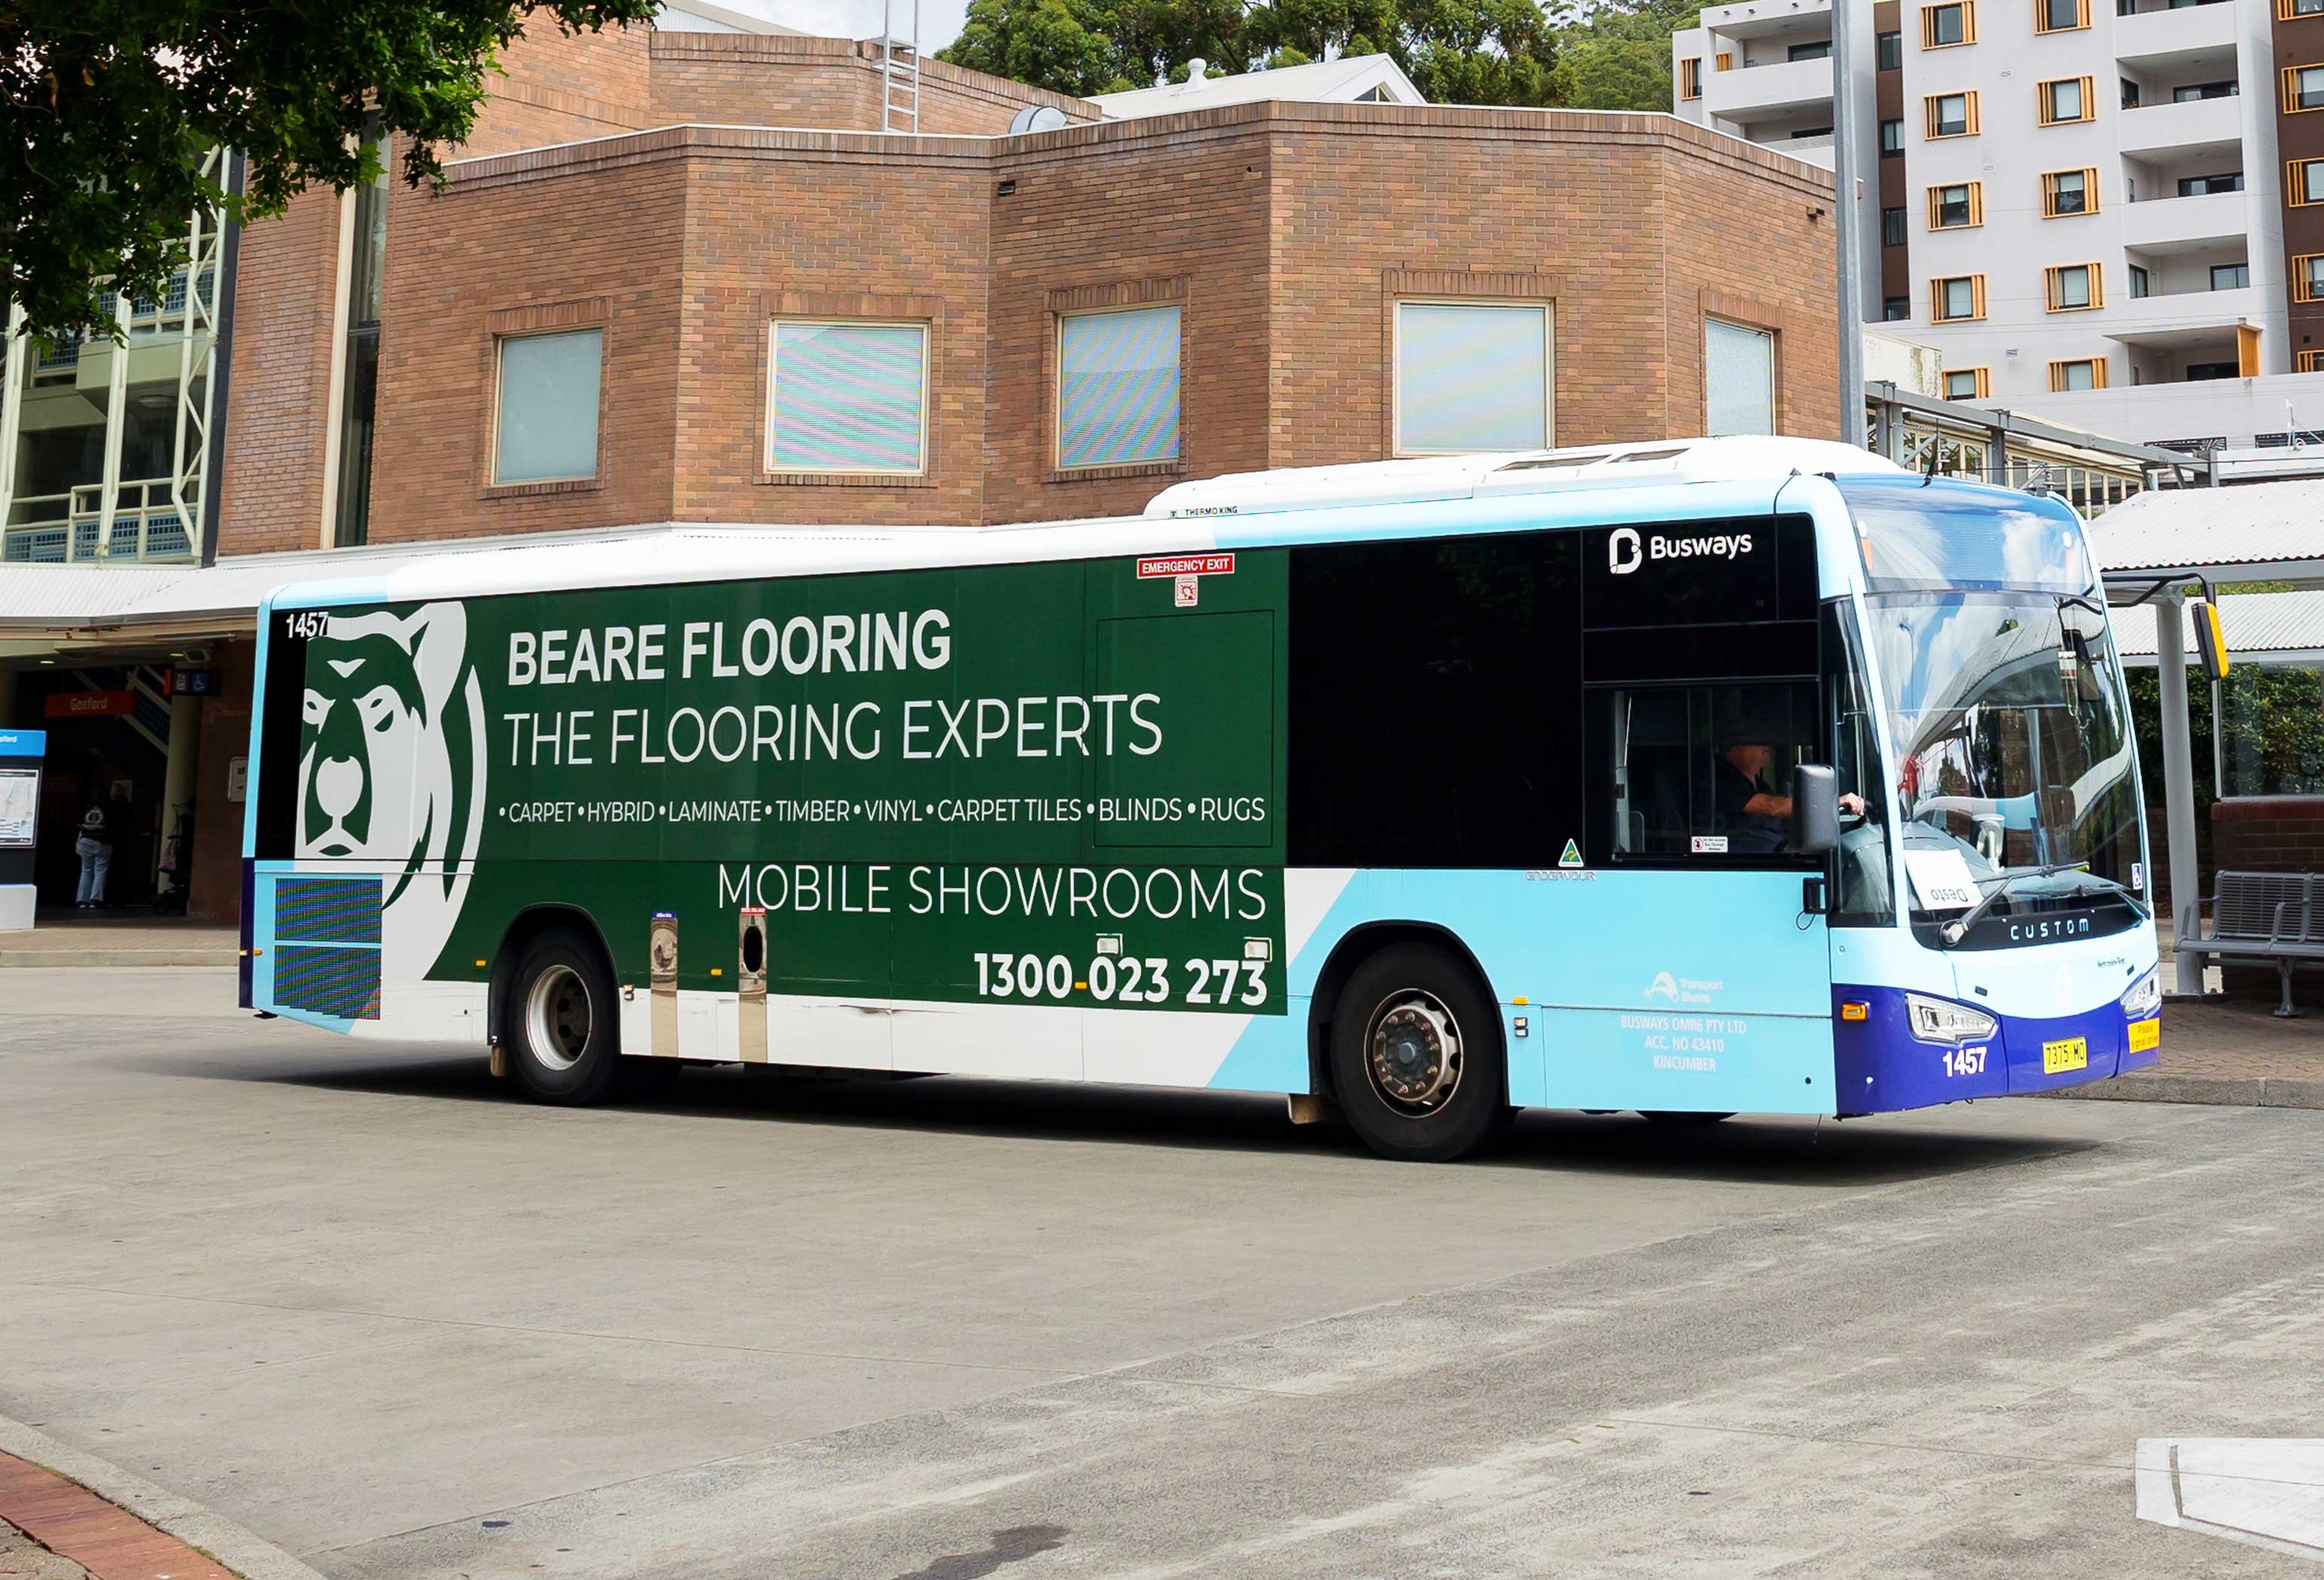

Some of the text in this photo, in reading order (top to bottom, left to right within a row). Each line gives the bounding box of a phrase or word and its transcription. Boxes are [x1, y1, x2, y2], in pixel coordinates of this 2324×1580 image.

[1185, 507, 1217, 516] THERMO
[1219, 506, 1237, 514] KING
[1651, 534, 1752, 560] Busways
[1142, 558, 1230, 573] EMERGENCY EXIT
[286, 611, 329, 638] 1457
[508, 609, 950, 686] BEARE FLOORING
[70, 697, 108, 711] Gosford
[503, 693, 1163, 766] THE FLOORING EXPERTS
[509, 797, 1265, 823] CARPET HYBRID LAMINATE TIMBER VINYL CARPET TILES BLINDS RUGS
[719, 863, 1266, 920] MOBILE SHOWROOMS
[2011, 918, 2089, 941] CUSTOM
[974, 952, 1267, 1006] 1300 023 273
[1621, 1015, 1747, 1034] BUSWAYS OMR6 PTY LTD
[1672, 1036, 1689, 1051] NO
[1692, 1038, 1724, 1053] 43410
[2046, 1044, 2069, 1066] 7375
[1653, 1056, 1717, 1071] KINCUMBER
[1942, 1047, 1987, 1077] 1457
